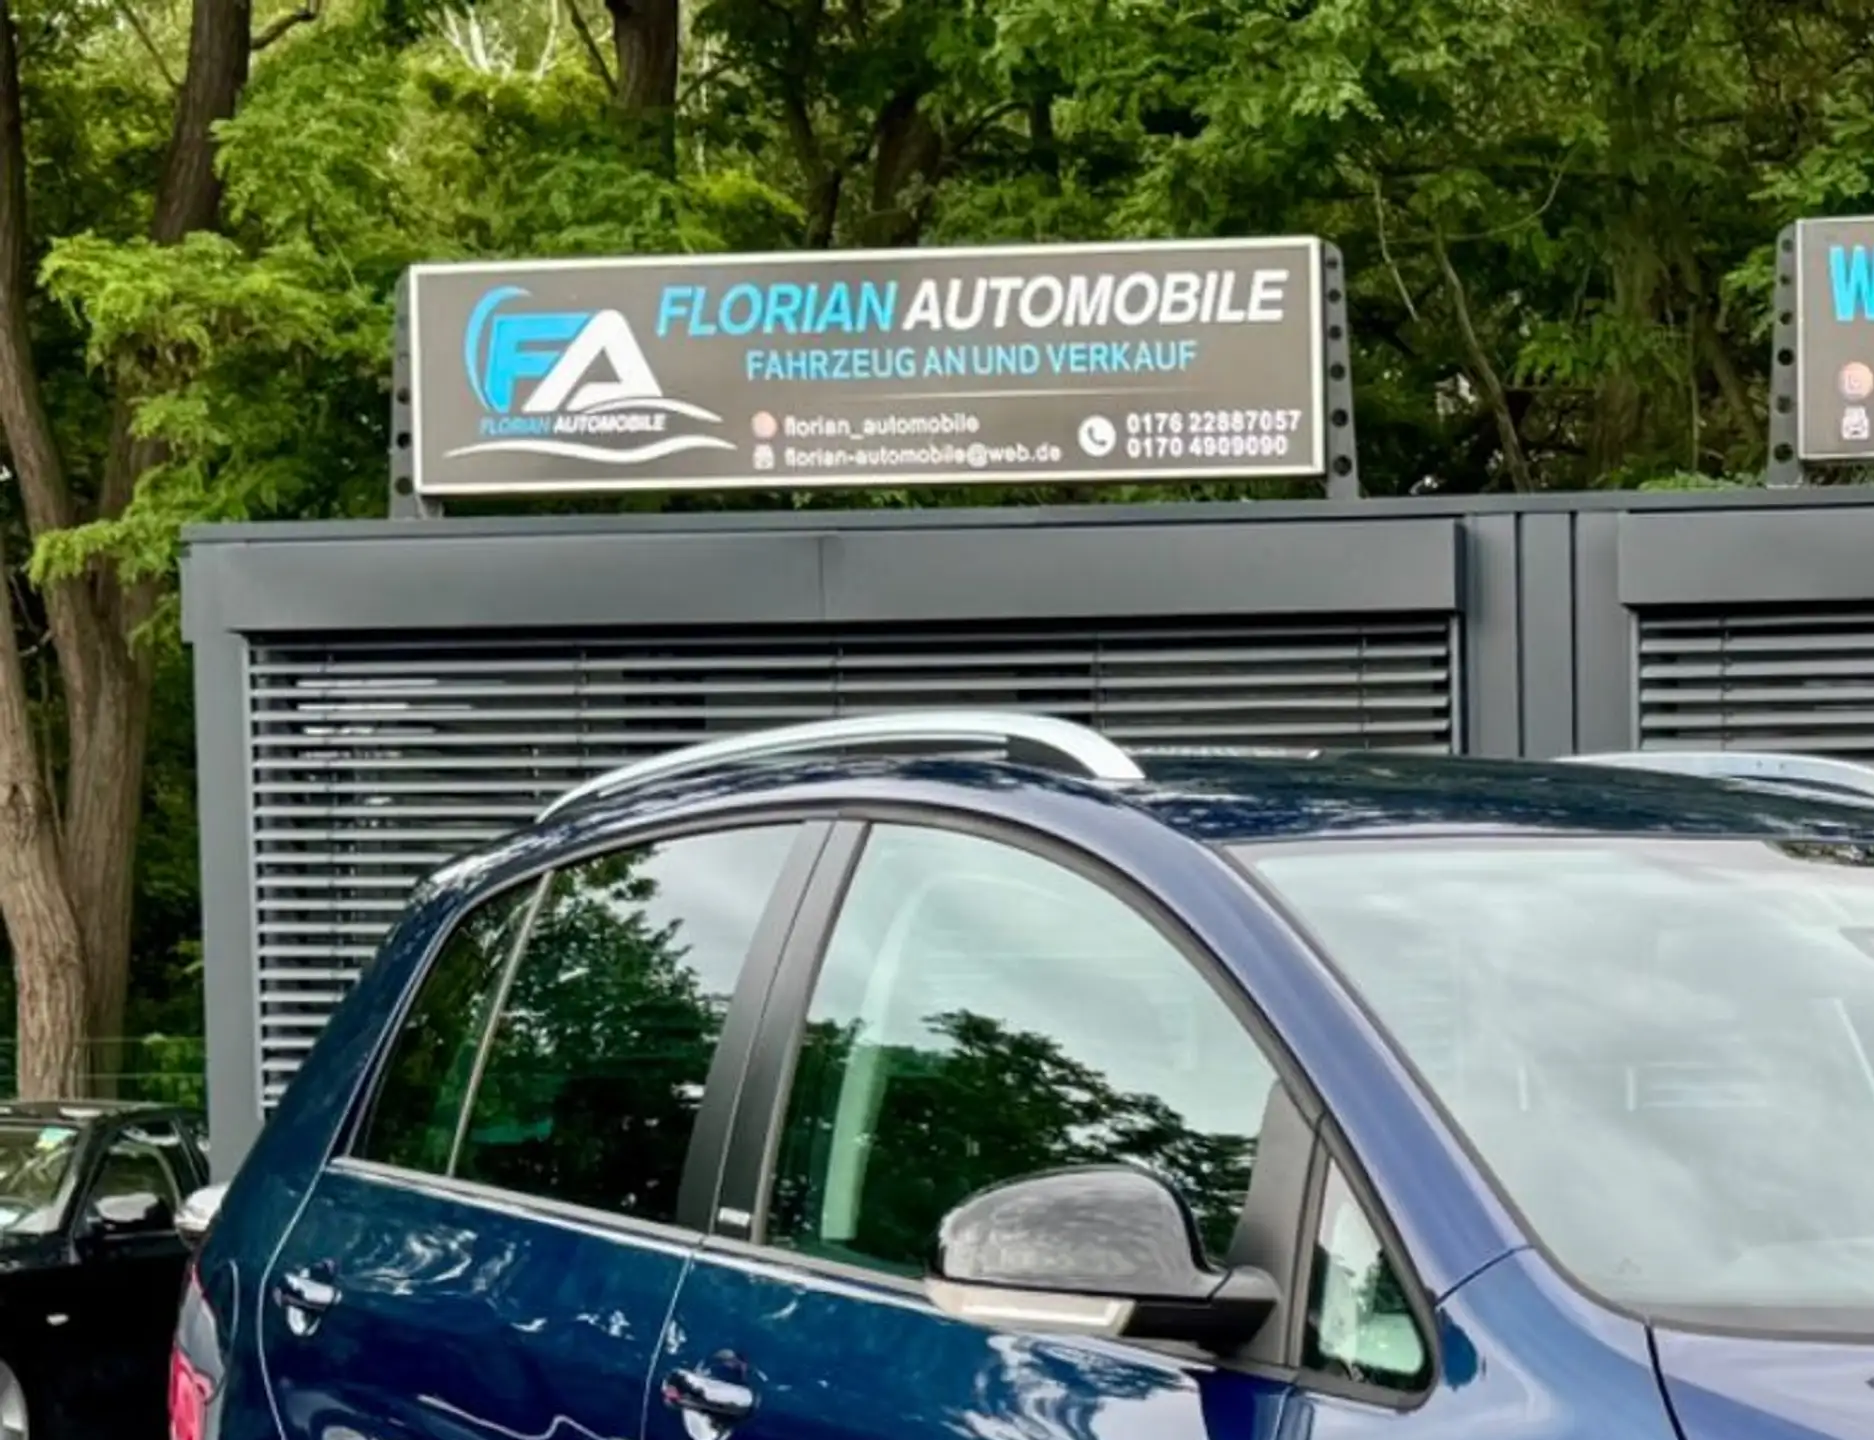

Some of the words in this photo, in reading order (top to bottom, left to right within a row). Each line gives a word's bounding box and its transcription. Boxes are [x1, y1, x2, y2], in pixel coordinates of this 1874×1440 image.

[655, 280, 898, 337] FLORIAN
[901, 270, 1290, 331] AUTOMOBILE
[745, 348, 916, 380] FAHRZEUG
[922, 346, 966, 377] AN
[973, 344, 1040, 375] UND
[1046, 340, 1198, 374] VERKAUF
[554, 413, 666, 434] AUTOMOBILE
[784, 412, 981, 440] florian_automobile
[1126, 412, 1183, 434] 0176
[1188, 409, 1302, 433] 22887057
[784, 442, 1062, 469] florian-automobile@web.de
[1126, 435, 1183, 458] 0170
[1188, 434, 1289, 457] 4909090
